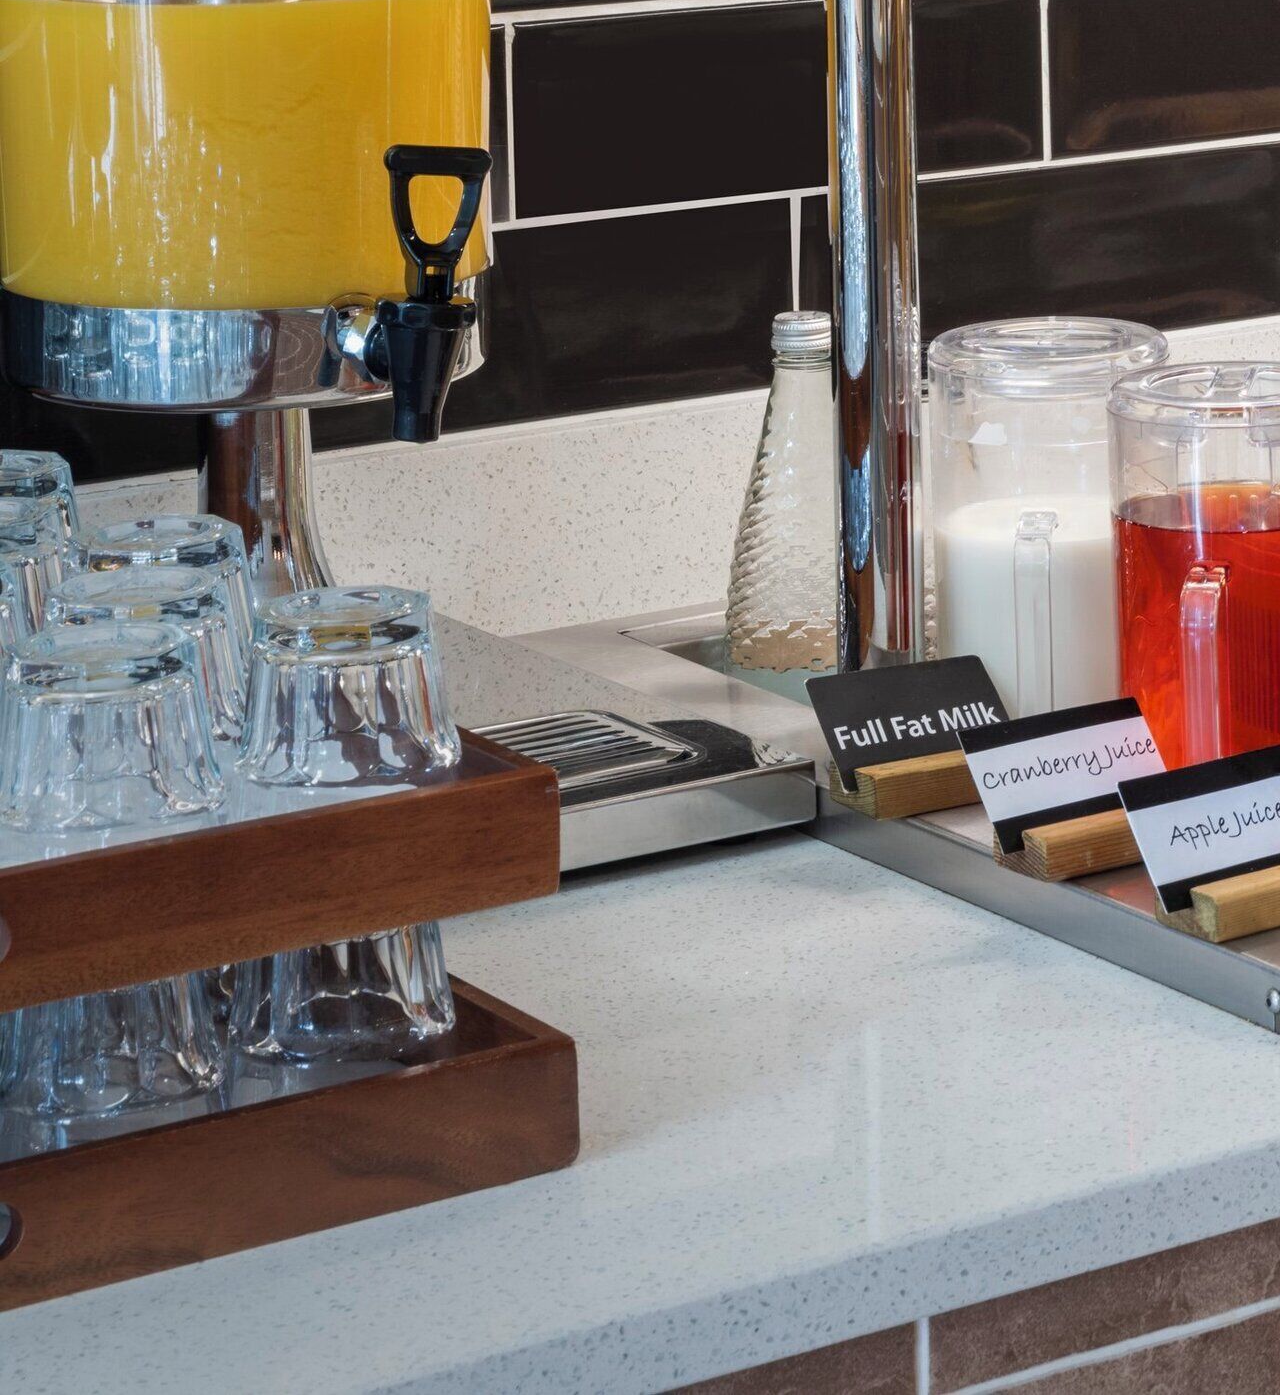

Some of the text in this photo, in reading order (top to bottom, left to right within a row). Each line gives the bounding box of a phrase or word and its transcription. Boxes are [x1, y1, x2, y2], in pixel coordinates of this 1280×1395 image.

[833, 702, 1001, 750] Full Fat Milk
[1098, 737, 1156, 769] Juice
[1170, 815, 1229, 850] Apple
